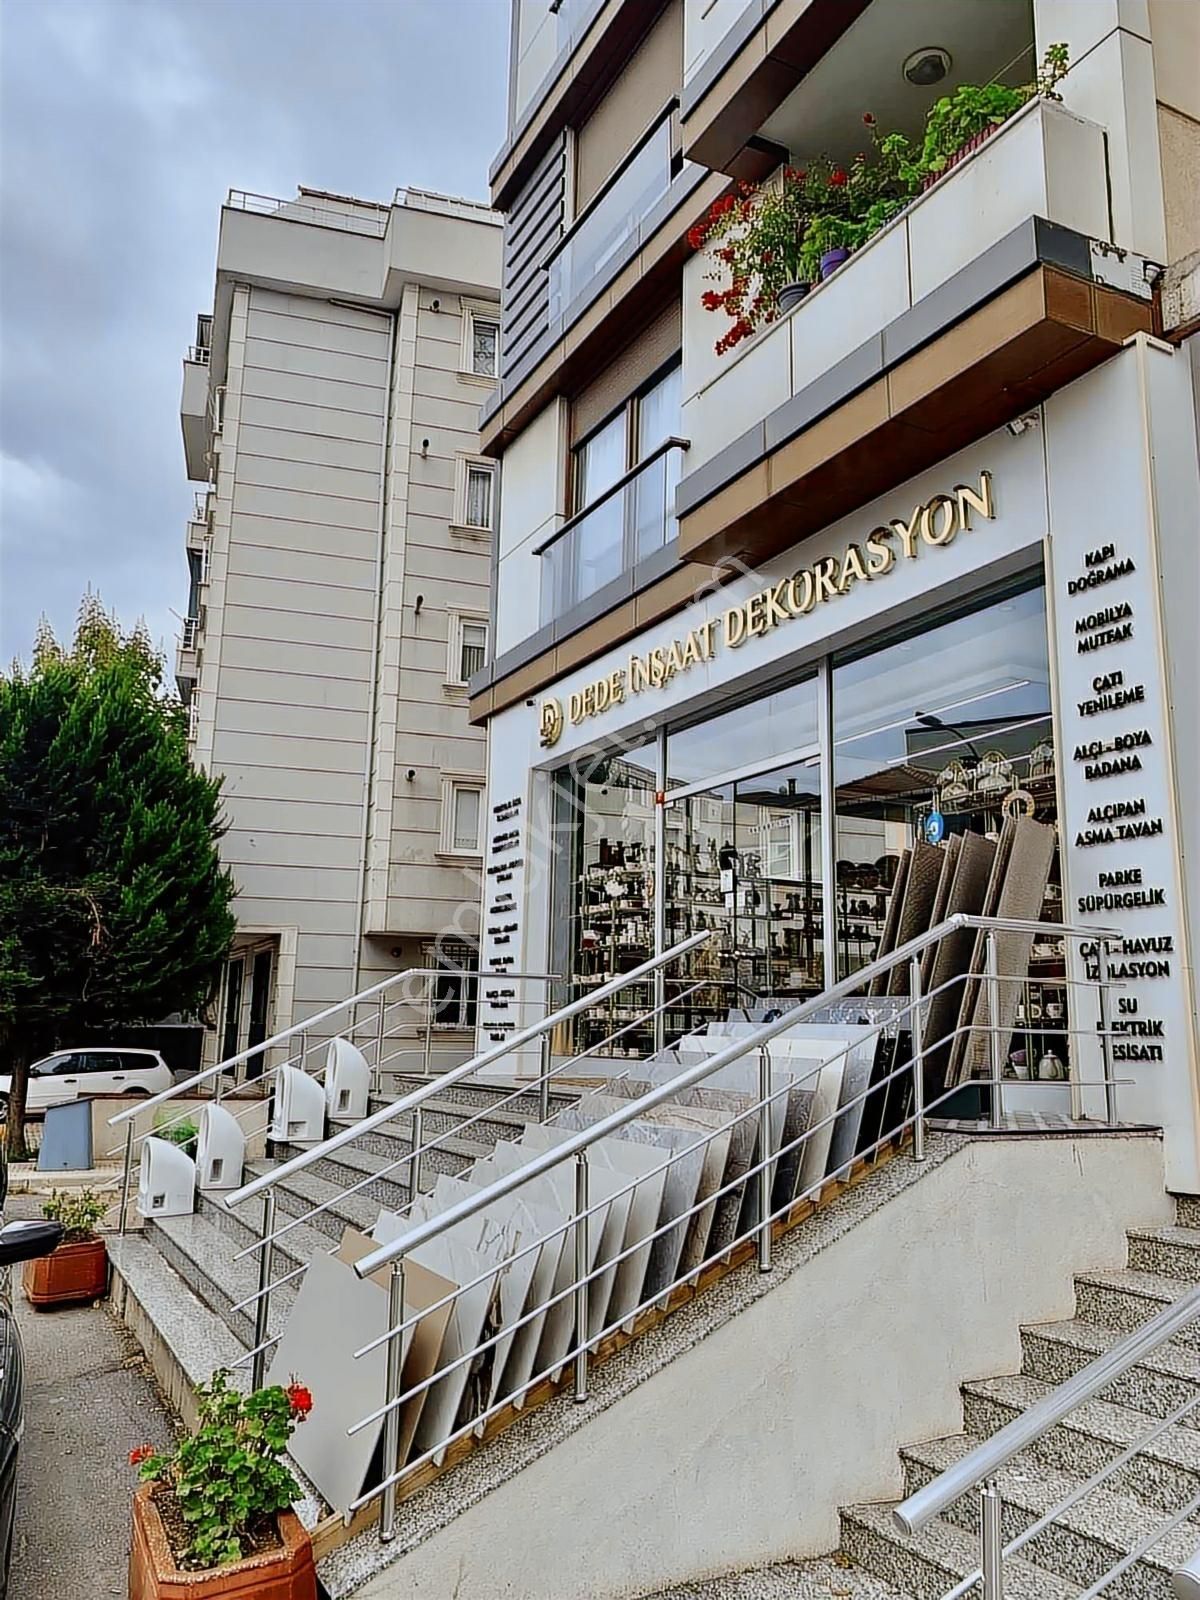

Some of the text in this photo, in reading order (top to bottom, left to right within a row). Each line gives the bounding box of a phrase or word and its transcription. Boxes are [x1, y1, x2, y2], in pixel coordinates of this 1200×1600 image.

[1085, 544, 1114, 568] KAPI
[1068, 558, 1135, 596] DOĞRAMA
[569, 470, 996, 725] DEDE İNŞAAT DEKORASYON
[1075, 602, 1133, 634] MOBİLYA
[1077, 623, 1133, 654] MUTFAK
[1093, 671, 1123, 695] ÇATI
[1077, 685, 1145, 717] YENİLEME
[1114, 730, 1152, 751] BOYA
[1085, 756, 1142, 781] BADANA
[1087, 800, 1145, 823] ALÇIPAN
[1075, 819, 1163, 847] ASMA TAVAN
[1099, 869, 1141, 888] PARKE
[1078, 888, 1165, 913] SÜPÜRGELİK
[1122, 936, 1173, 954] HAVUZ
[1086, 961, 1170, 980] İZLASYON
[1119, 998, 1138, 1014] SU
[1097, 1019, 1164, 1037] EEKTRİK
[1100, 1043, 1163, 1061] ESİSATI
